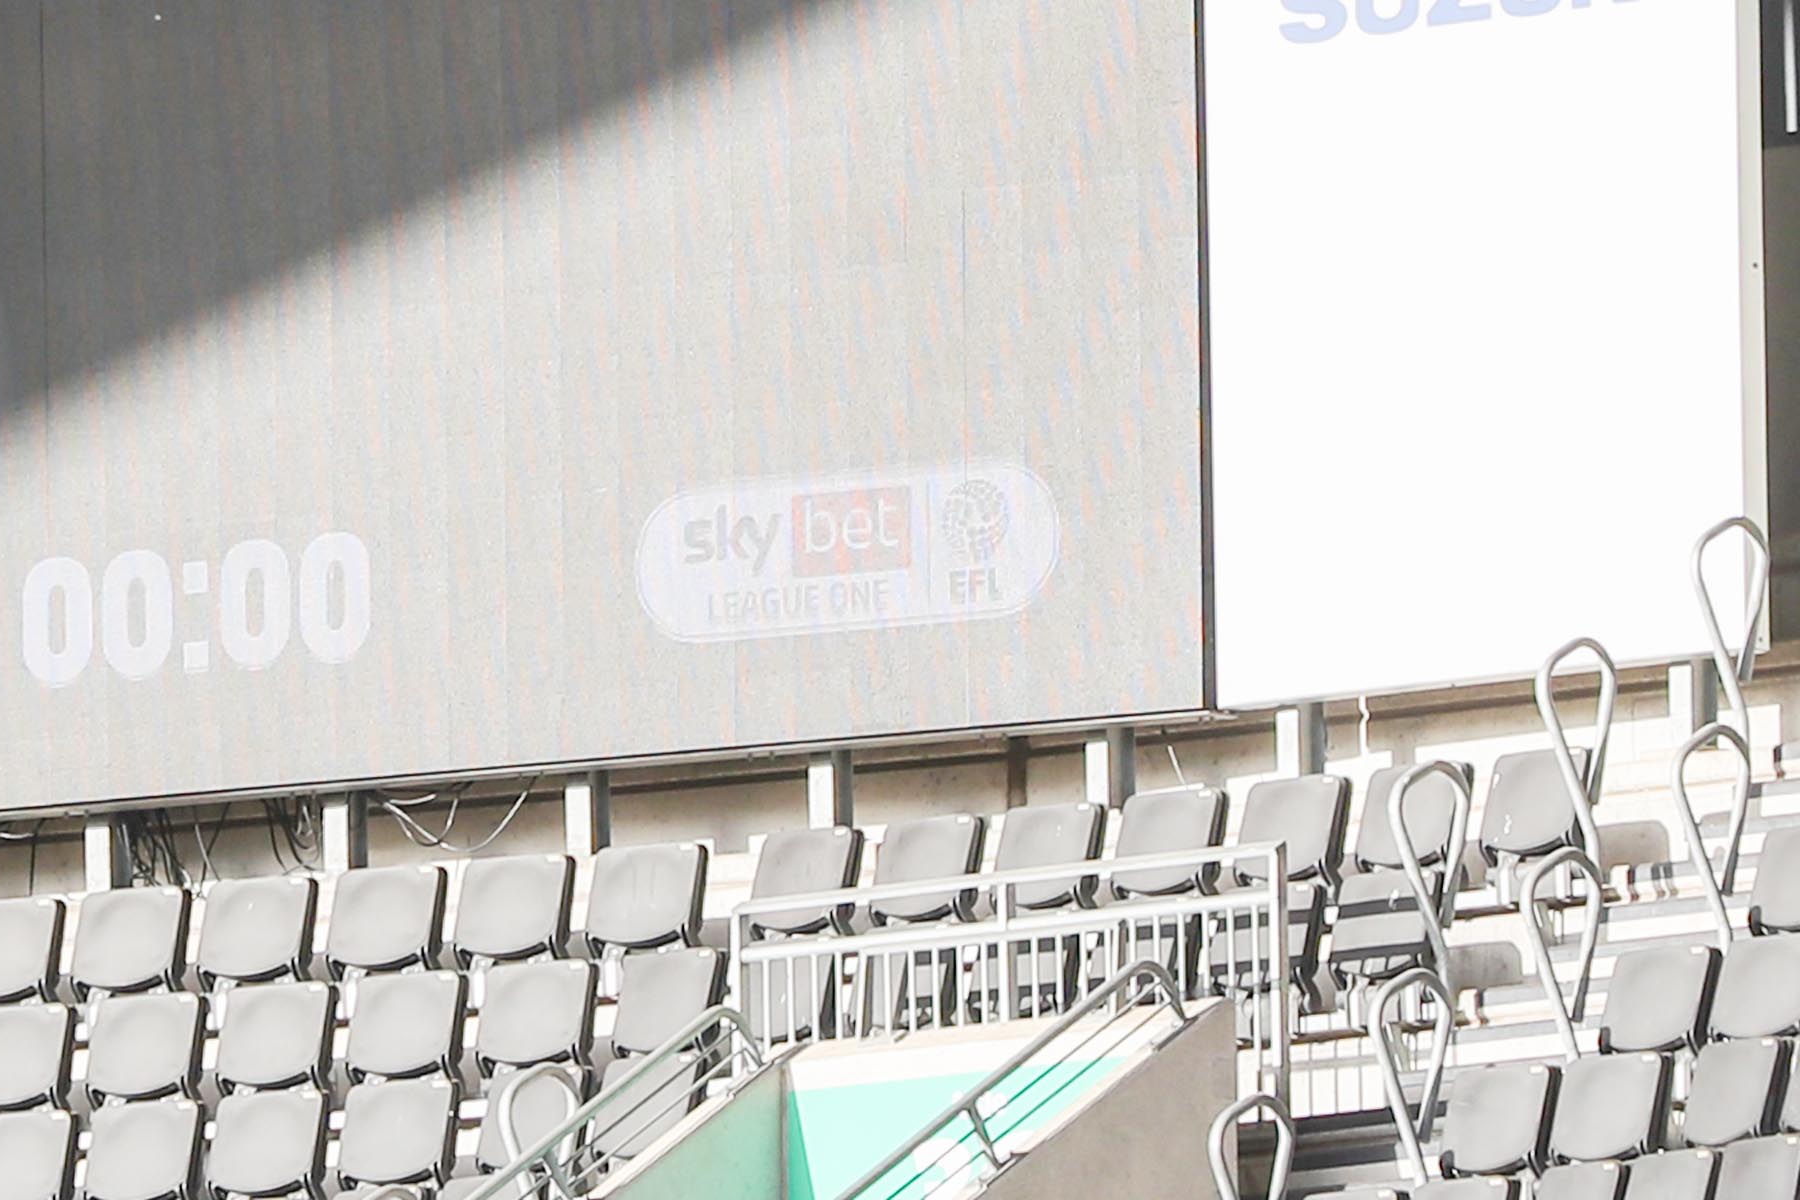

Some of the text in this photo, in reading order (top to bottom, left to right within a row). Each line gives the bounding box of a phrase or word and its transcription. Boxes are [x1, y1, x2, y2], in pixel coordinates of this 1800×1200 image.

[683, 498, 899, 577] sky bet
[22, 531, 371, 688] 00:00
[706, 579, 890, 623] LEAGUE ONE
[948, 567, 1001, 603] EFL
